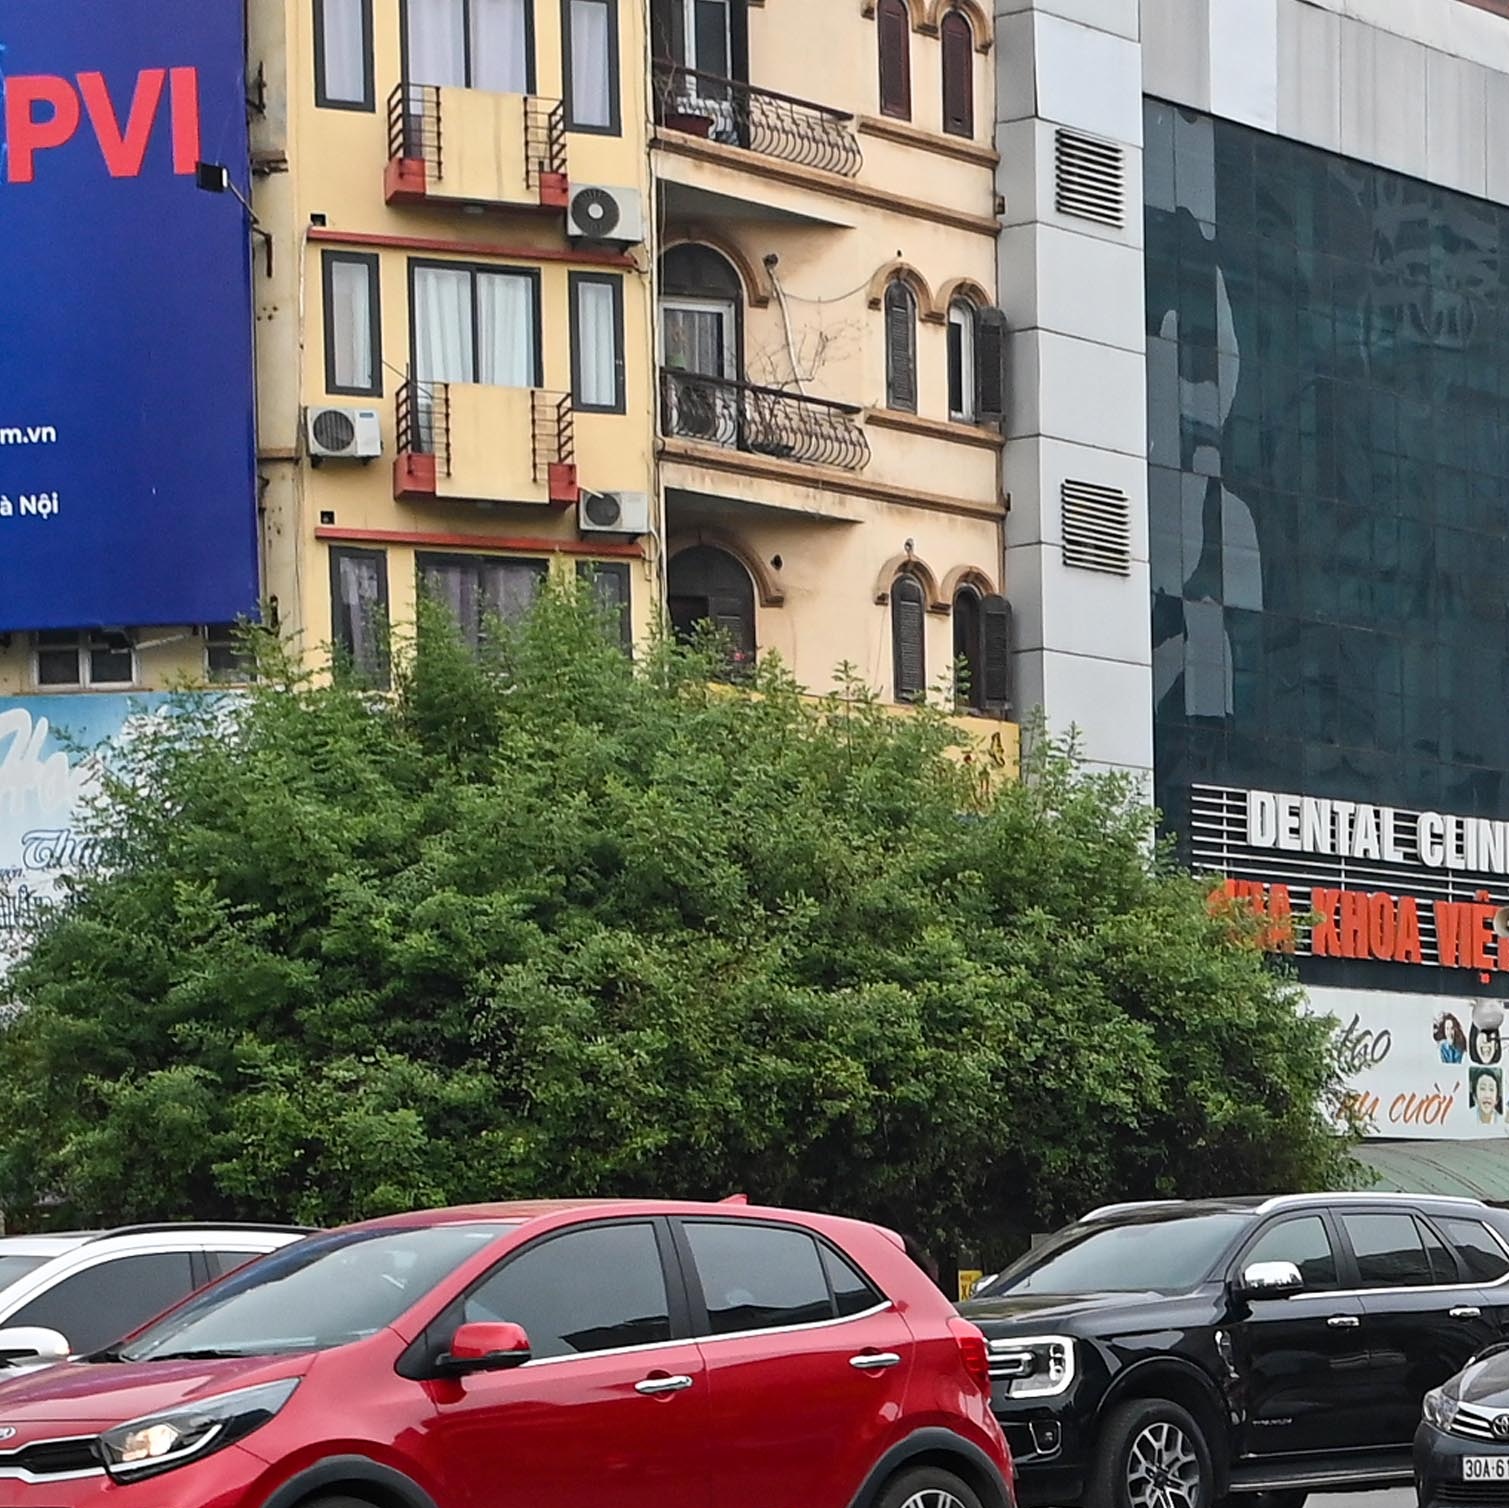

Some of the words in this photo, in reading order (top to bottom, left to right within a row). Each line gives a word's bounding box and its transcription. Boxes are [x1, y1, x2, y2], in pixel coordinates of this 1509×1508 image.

[5, 66, 201, 183] PVI
[20, 491, 59, 519] Nội
[1247, 790, 1403, 862] DENTAL
[1311, 887, 1422, 963] KHOA
[1389, 1081, 1460, 1125] cười
